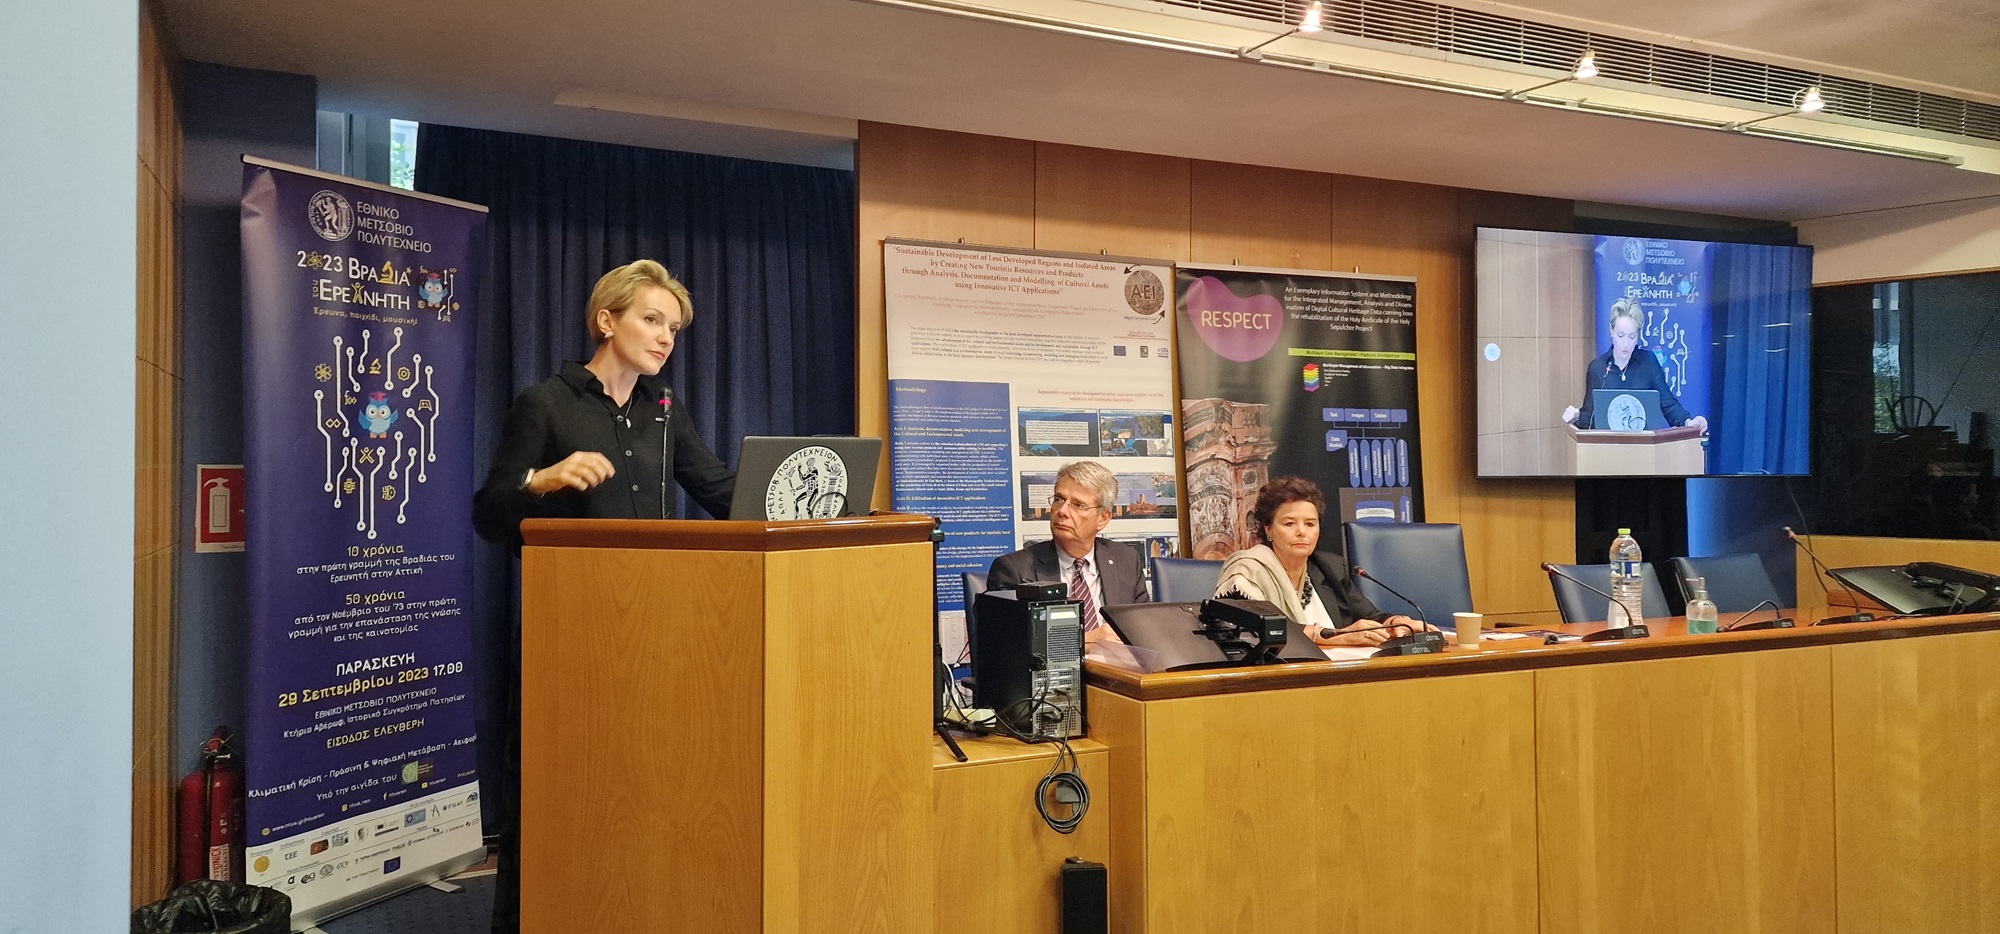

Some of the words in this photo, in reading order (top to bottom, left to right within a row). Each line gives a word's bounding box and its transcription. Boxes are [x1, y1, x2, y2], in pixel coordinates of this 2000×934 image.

[356, 202, 400, 220] ΕΘΝΙΚΟ
[357, 216, 414, 236] ΜΕΤΣΟΒΙΟ
[358, 230, 432, 253] ΠΟΛΥΤΕΧΝΕΙΟ
[930, 260, 938, 268] by
[940, 260, 968, 269] Creating
[986, 264, 1012, 272] Touristic
[1014, 266, 1044, 275] Resources
[1058, 270, 1084, 278] Products
[936, 250, 979, 260] Development
[1004, 256, 1036, 265] Developed
[1038, 258, 1062, 267] Regions
[1075, 262, 1098, 270] Isolated
[902, 267, 928, 277] through
[930, 269, 959, 279] Analysis,
[961, 272, 1008, 281] Documentation
[1023, 277, 1055, 286] Modelling
[1065, 280, 1089, 288] Cultural
[955, 282, 972, 290] using
[974, 282, 1007, 291] Innovative
[1294, 287, 1320, 295] Exemplary
[1202, 310, 1271, 330] RESPECT
[1400, 318, 1410, 326] Holy
[347, 546, 359, 556] 10
[363, 543, 404, 558] χρόνια
[296, 566, 320, 574] στην
[322, 562, 347, 572] πρώτη
[349, 558, 382, 570] γραμμή
[385, 558, 400, 566] της
[402, 554, 437, 565] Βραδιάς
[330, 570, 368, 584] Ερευνητή
[371, 570, 393, 578] στην
[395, 566, 422, 576] Αττική
[346, 594, 360, 605] 50
[364, 590, 405, 605] χρόνια
[294, 614, 314, 624] από
[316, 614, 331, 622] τον
[332, 608, 371, 619] Νοέμβριο
[407, 601, 427, 610] στην
[429, 597, 456, 607] πρώτη
[288, 624, 323, 639] γραμμή
[325, 625, 337, 633] για
[340, 622, 353, 630] την
[355, 614, 412, 627] επανάσταση
[431, 608, 461, 618] γνώσης
[348, 632, 363, 640] της
[366, 624, 418, 637] καινοτομίας
[336, 653, 415, 676] ΠΑΡΑΣΚΕΥΗ
[302, 675, 393, 703] Σεπτεμβρίου
[398, 667, 429, 683] 2023
[433, 661, 463, 676] 17.00
[344, 698, 384, 712] ΜΕΤΣΟΒΙΟ
[386, 688, 437, 703] ΠΟΛΥΤΕΧΝΕΙΟ
[326, 730, 370, 748] ΕΙΣΟΔΟΣ
[374, 718, 424, 737] ΕΛΕΥΘΕΡΗ
[248, 780, 296, 798] Κλιματική
[408, 744, 446, 757] Μετάβαση
[316, 791, 333, 801] Υπό
[336, 787, 348, 796] την
[351, 778, 379, 791] αιγίδα
[382, 774, 397, 783] του
